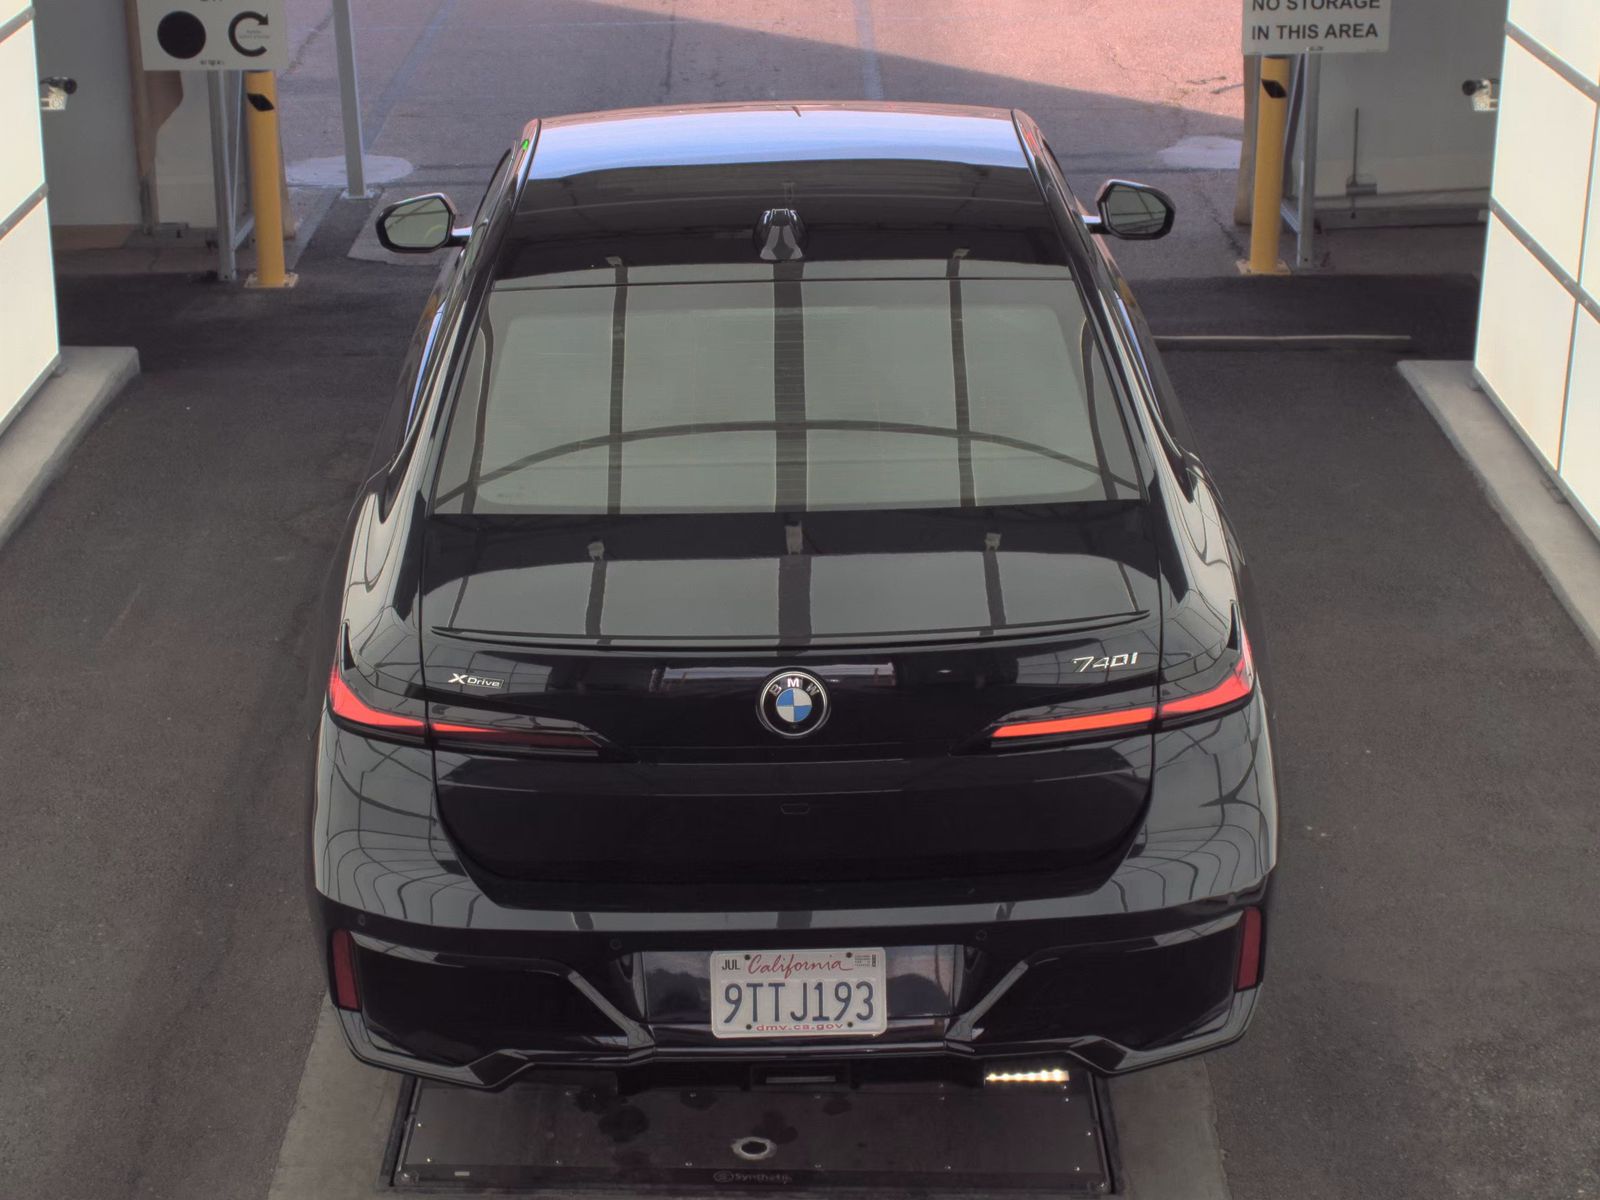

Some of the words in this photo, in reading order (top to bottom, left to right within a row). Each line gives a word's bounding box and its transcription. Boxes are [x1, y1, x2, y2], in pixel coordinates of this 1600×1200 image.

[1252, 0, 1280, 11] NO
[1286, 0, 1380, 10] STORAGE
[1252, 26, 1269, 40] IN
[1276, 24, 1319, 40] THIS
[1324, 23, 1378, 39] AREA
[769, 677, 820, 697] BMW
[722, 959, 740, 970] JUL
[748, 953, 854, 979] California
[723, 981, 875, 1023] 9TTJ193
[756, 1023, 844, 1033] dmv.ca.gov
